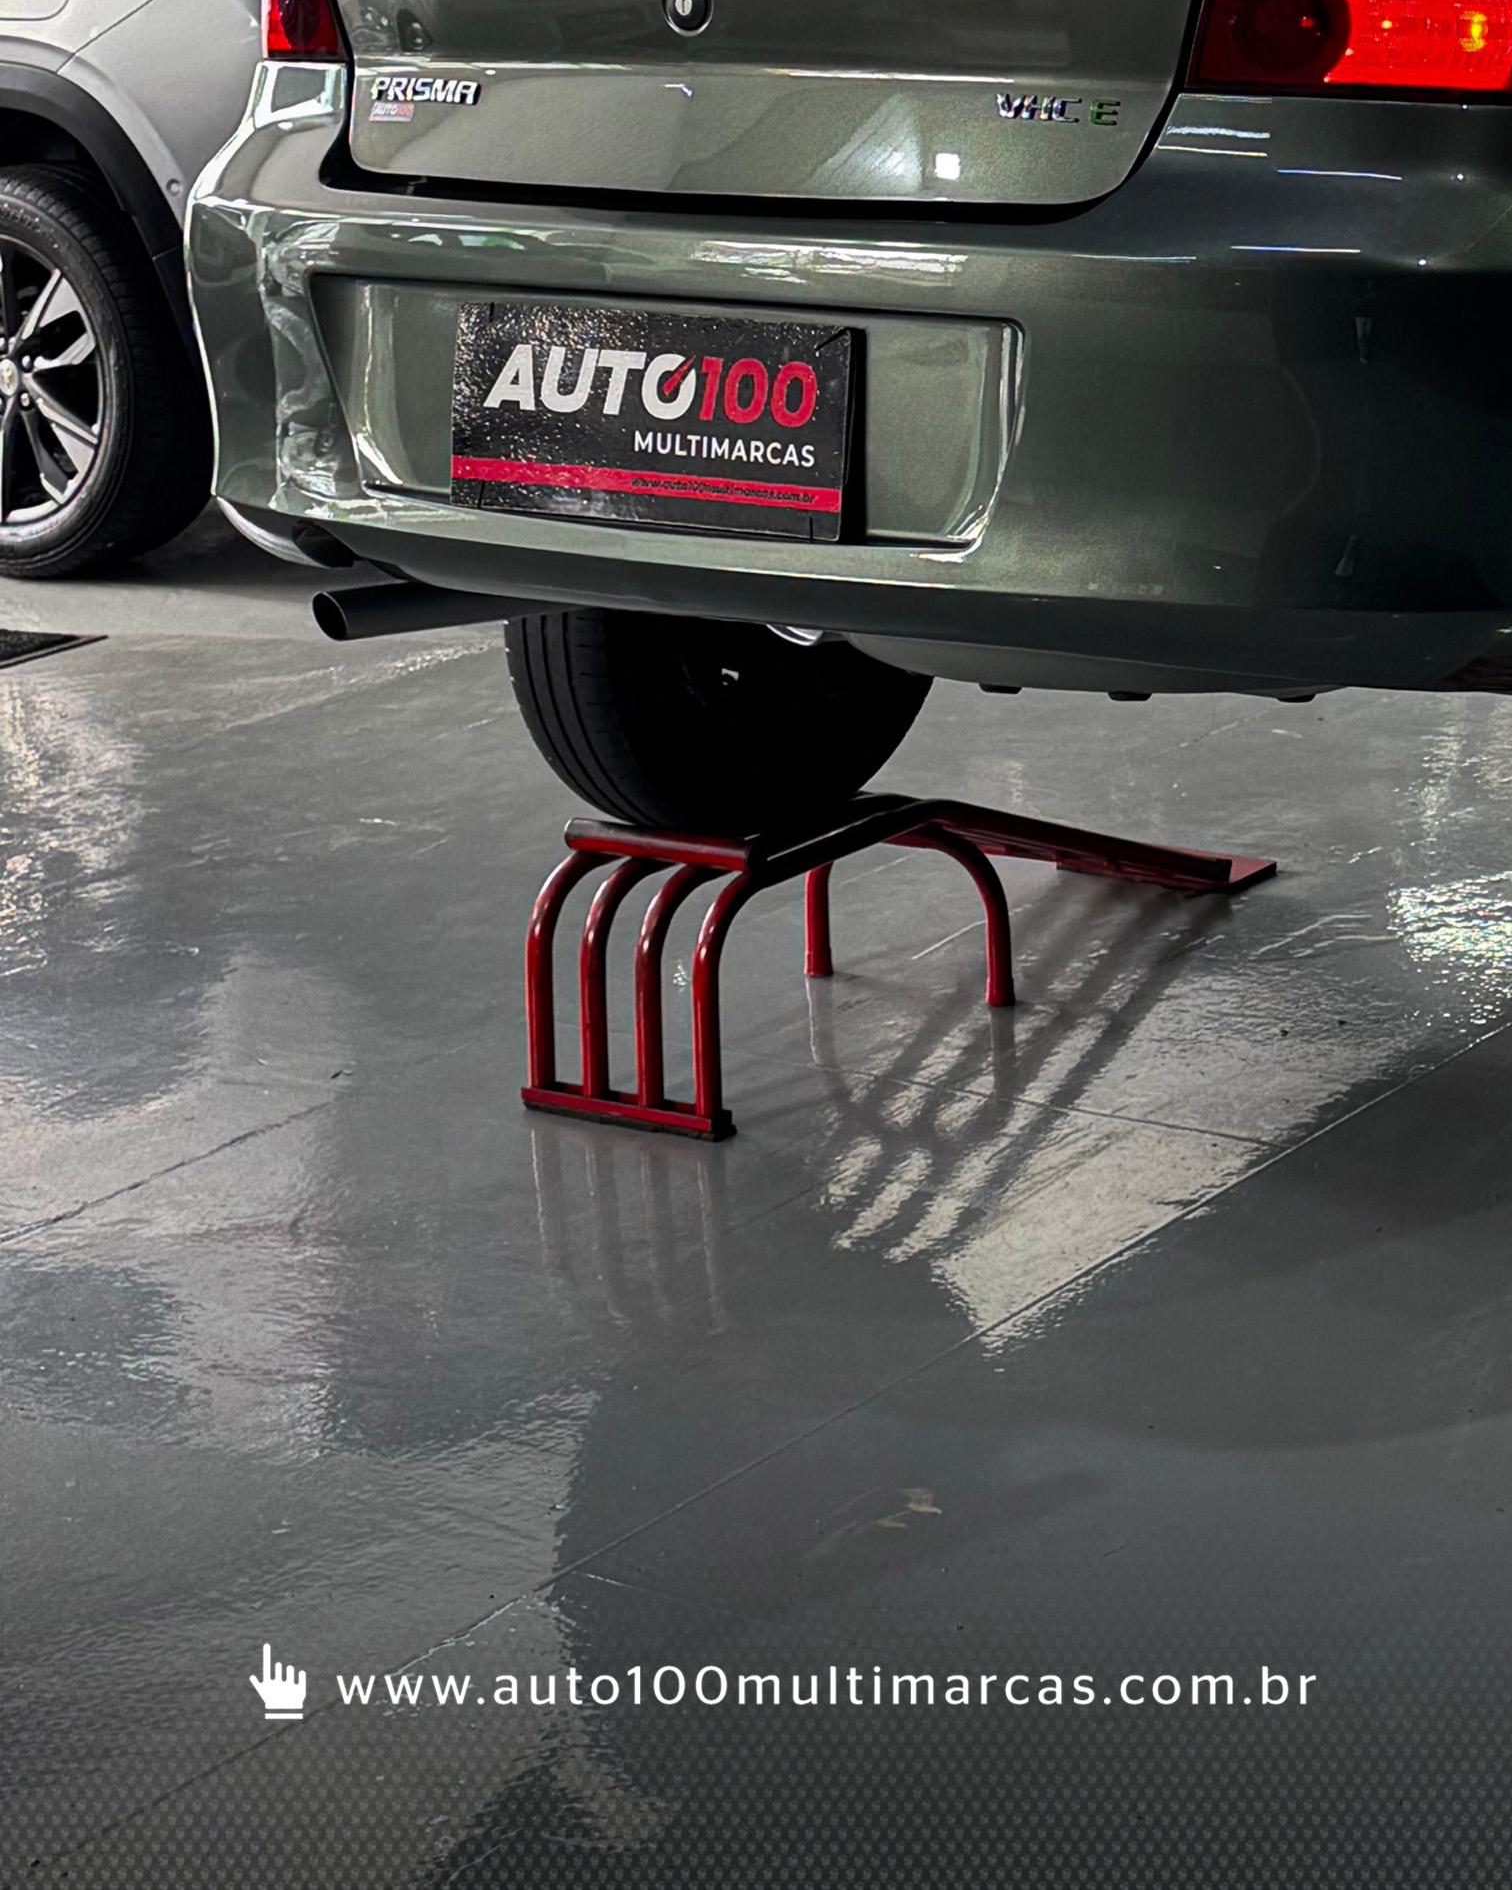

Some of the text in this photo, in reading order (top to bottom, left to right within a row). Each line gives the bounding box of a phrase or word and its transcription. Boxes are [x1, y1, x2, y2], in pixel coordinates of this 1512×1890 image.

[370, 76, 481, 105] PRISMA
[483, 343, 818, 428] AUTO100
[633, 430, 816, 468] MULTIMARCAS
